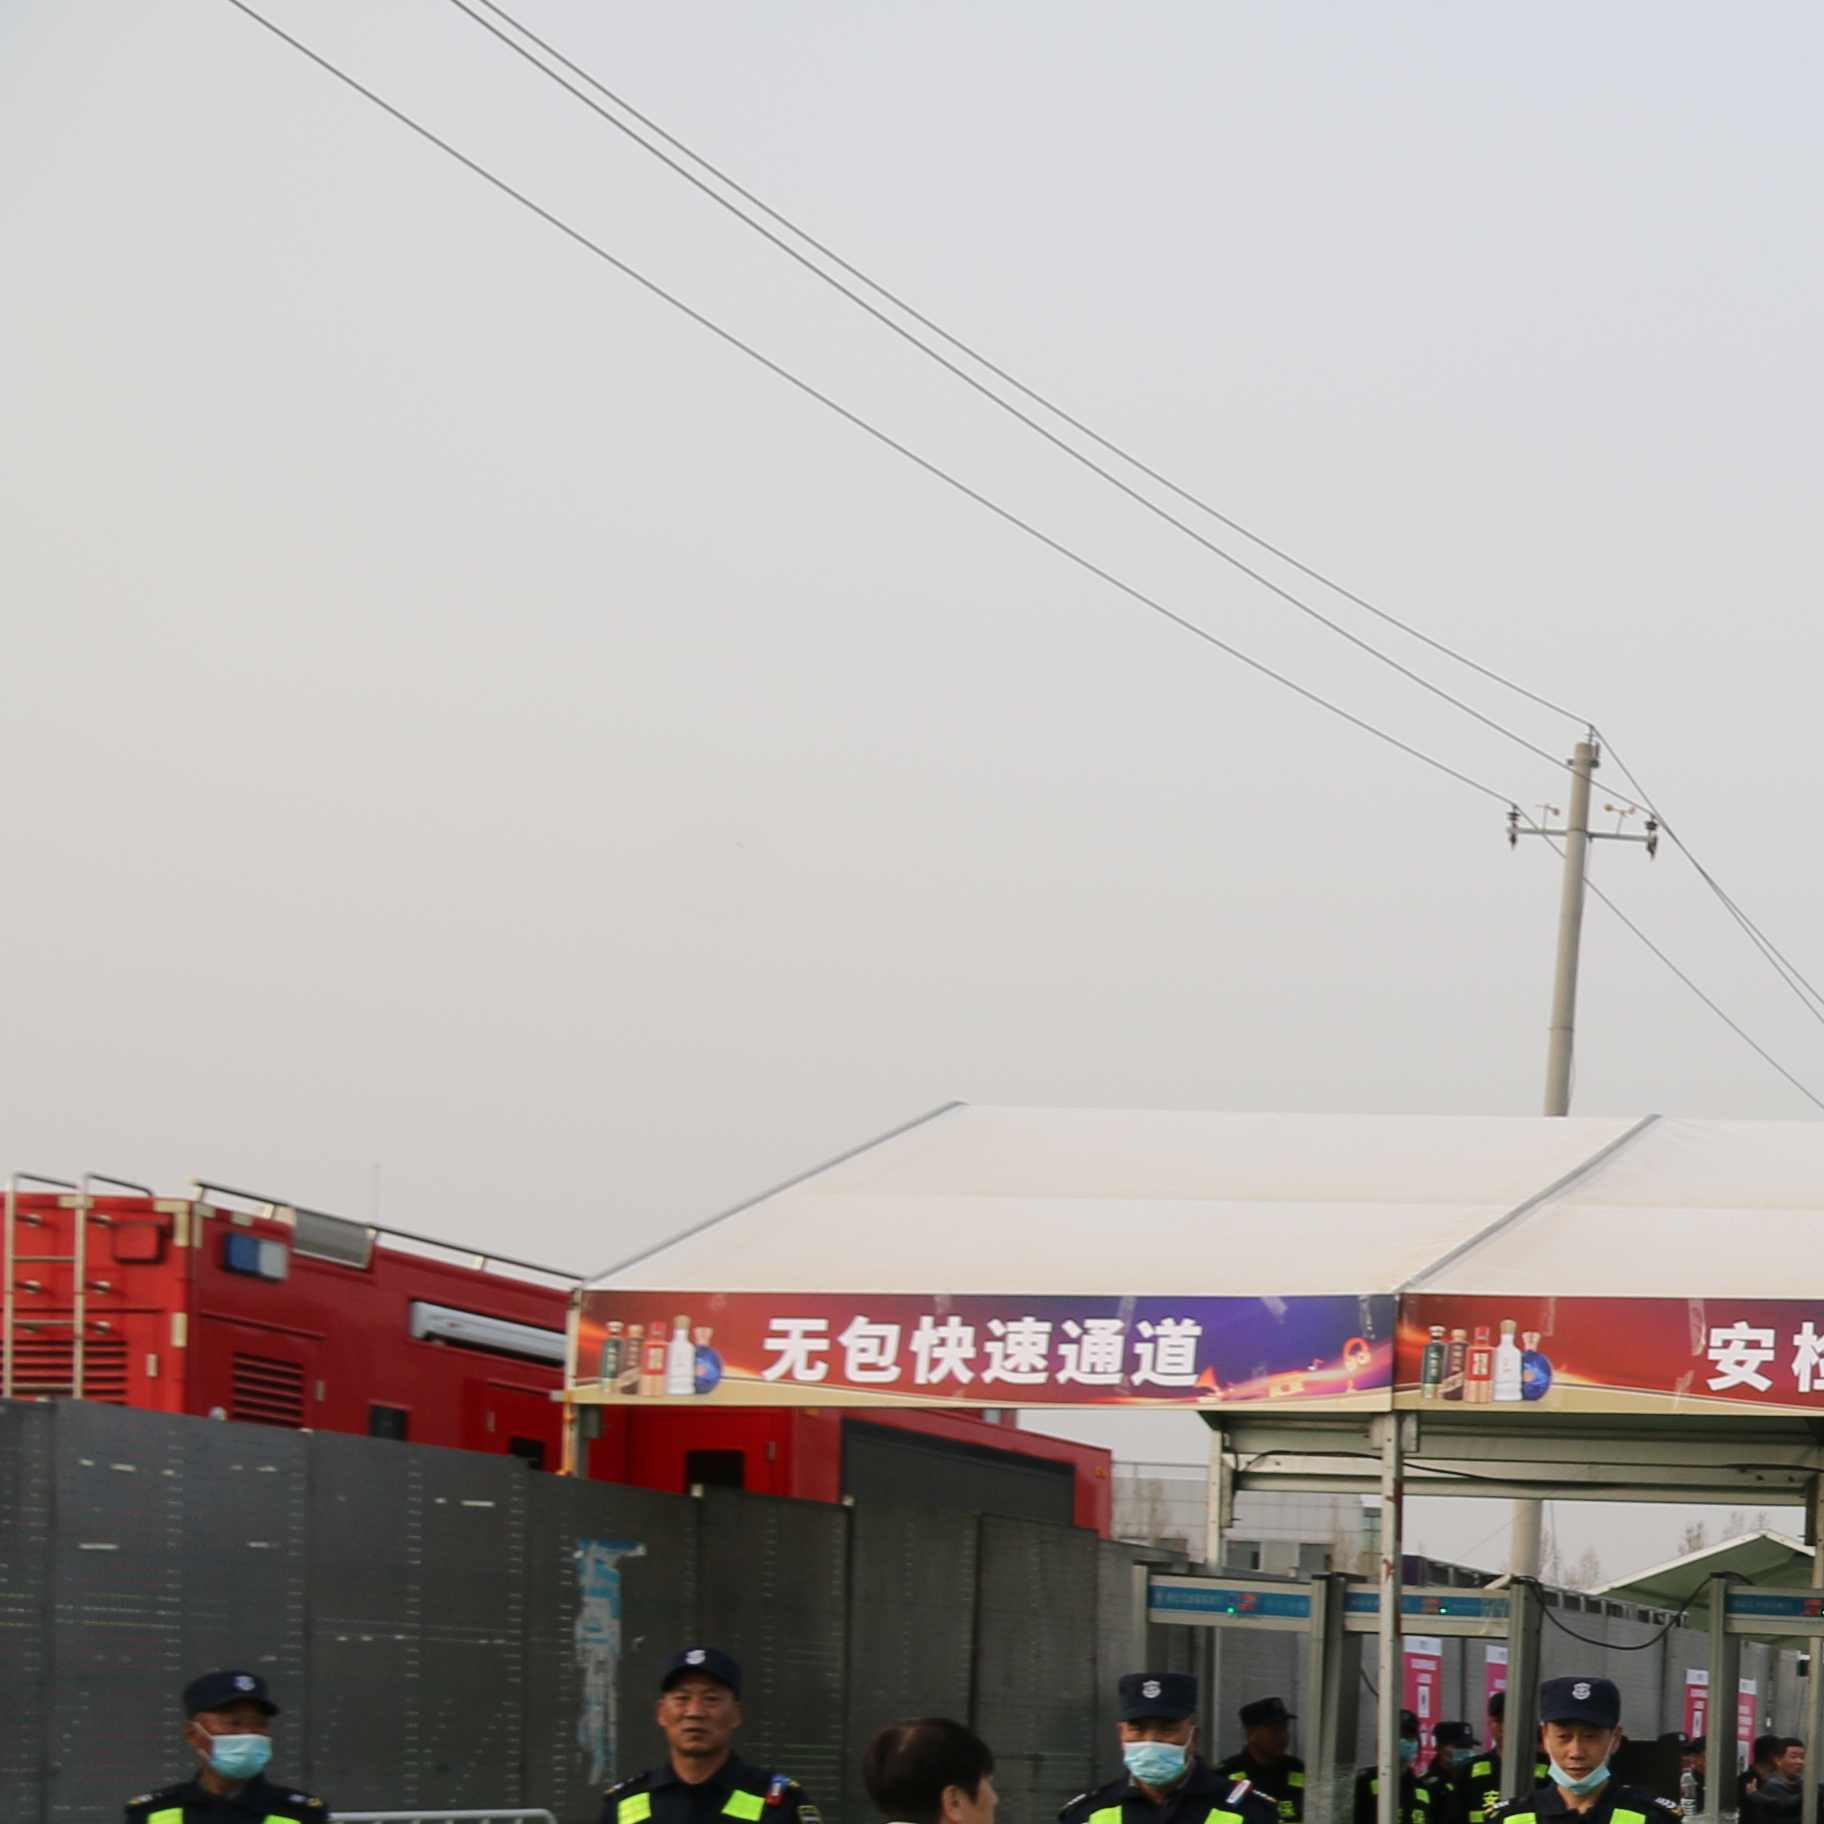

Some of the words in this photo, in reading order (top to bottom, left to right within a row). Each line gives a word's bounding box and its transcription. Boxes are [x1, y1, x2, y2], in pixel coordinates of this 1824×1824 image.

[760, 1315, 1203, 1387] 无包快速通道
